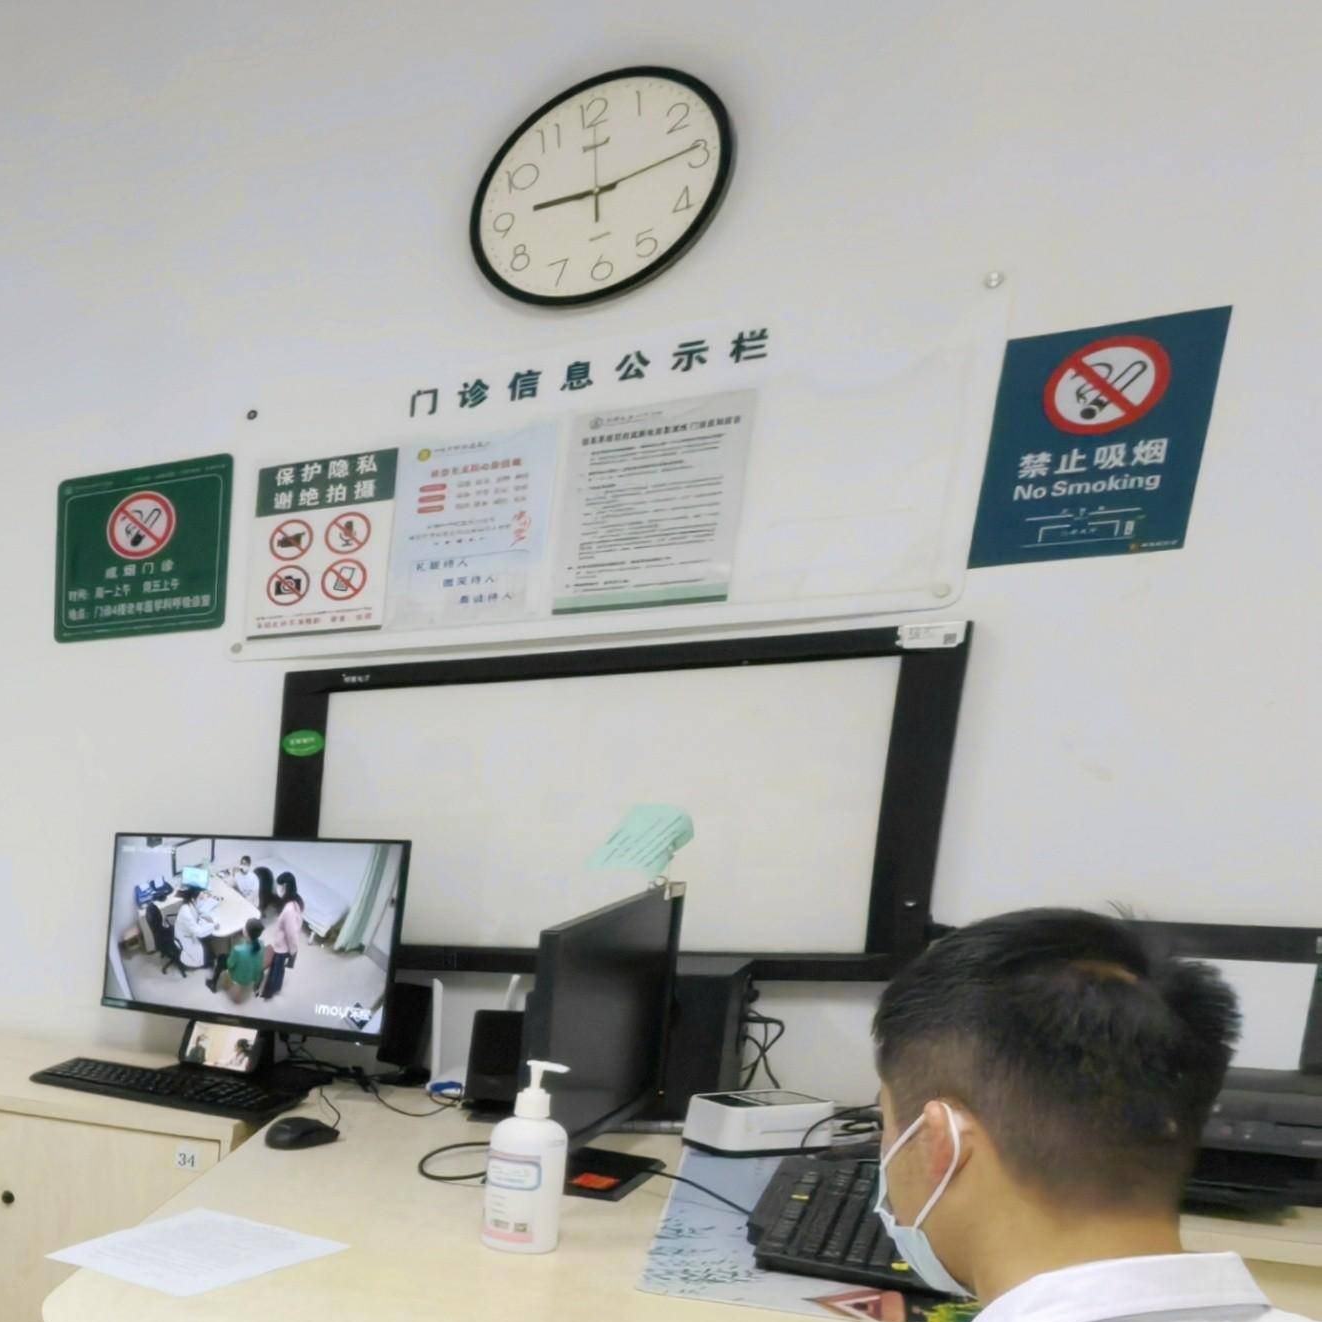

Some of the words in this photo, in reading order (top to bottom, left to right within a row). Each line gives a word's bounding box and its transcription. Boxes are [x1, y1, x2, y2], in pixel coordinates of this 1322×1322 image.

[580, 97, 608, 129] 12
[635, 89, 642, 117] 1
[665, 101, 690, 134] 2
[536, 122, 561, 154] 11
[687, 138, 710, 169] 3
[506, 163, 540, 194] 10
[672, 185, 695, 213] 4
[492, 212, 515, 239] 9
[510, 243, 531, 272] 8
[635, 228, 658, 258] 5
[547, 257, 569, 287] 7
[590, 254, 614, 281] 6
[409, 327, 769, 418] 门诊信息公示栏
[274, 453, 378, 487] 保护隐私
[1016, 438, 1169, 480] 禁止吸烟
[1012, 484, 1047, 502] No
[1050, 474, 1162, 498] Smoking
[177, 1151, 196, 1168] 34
